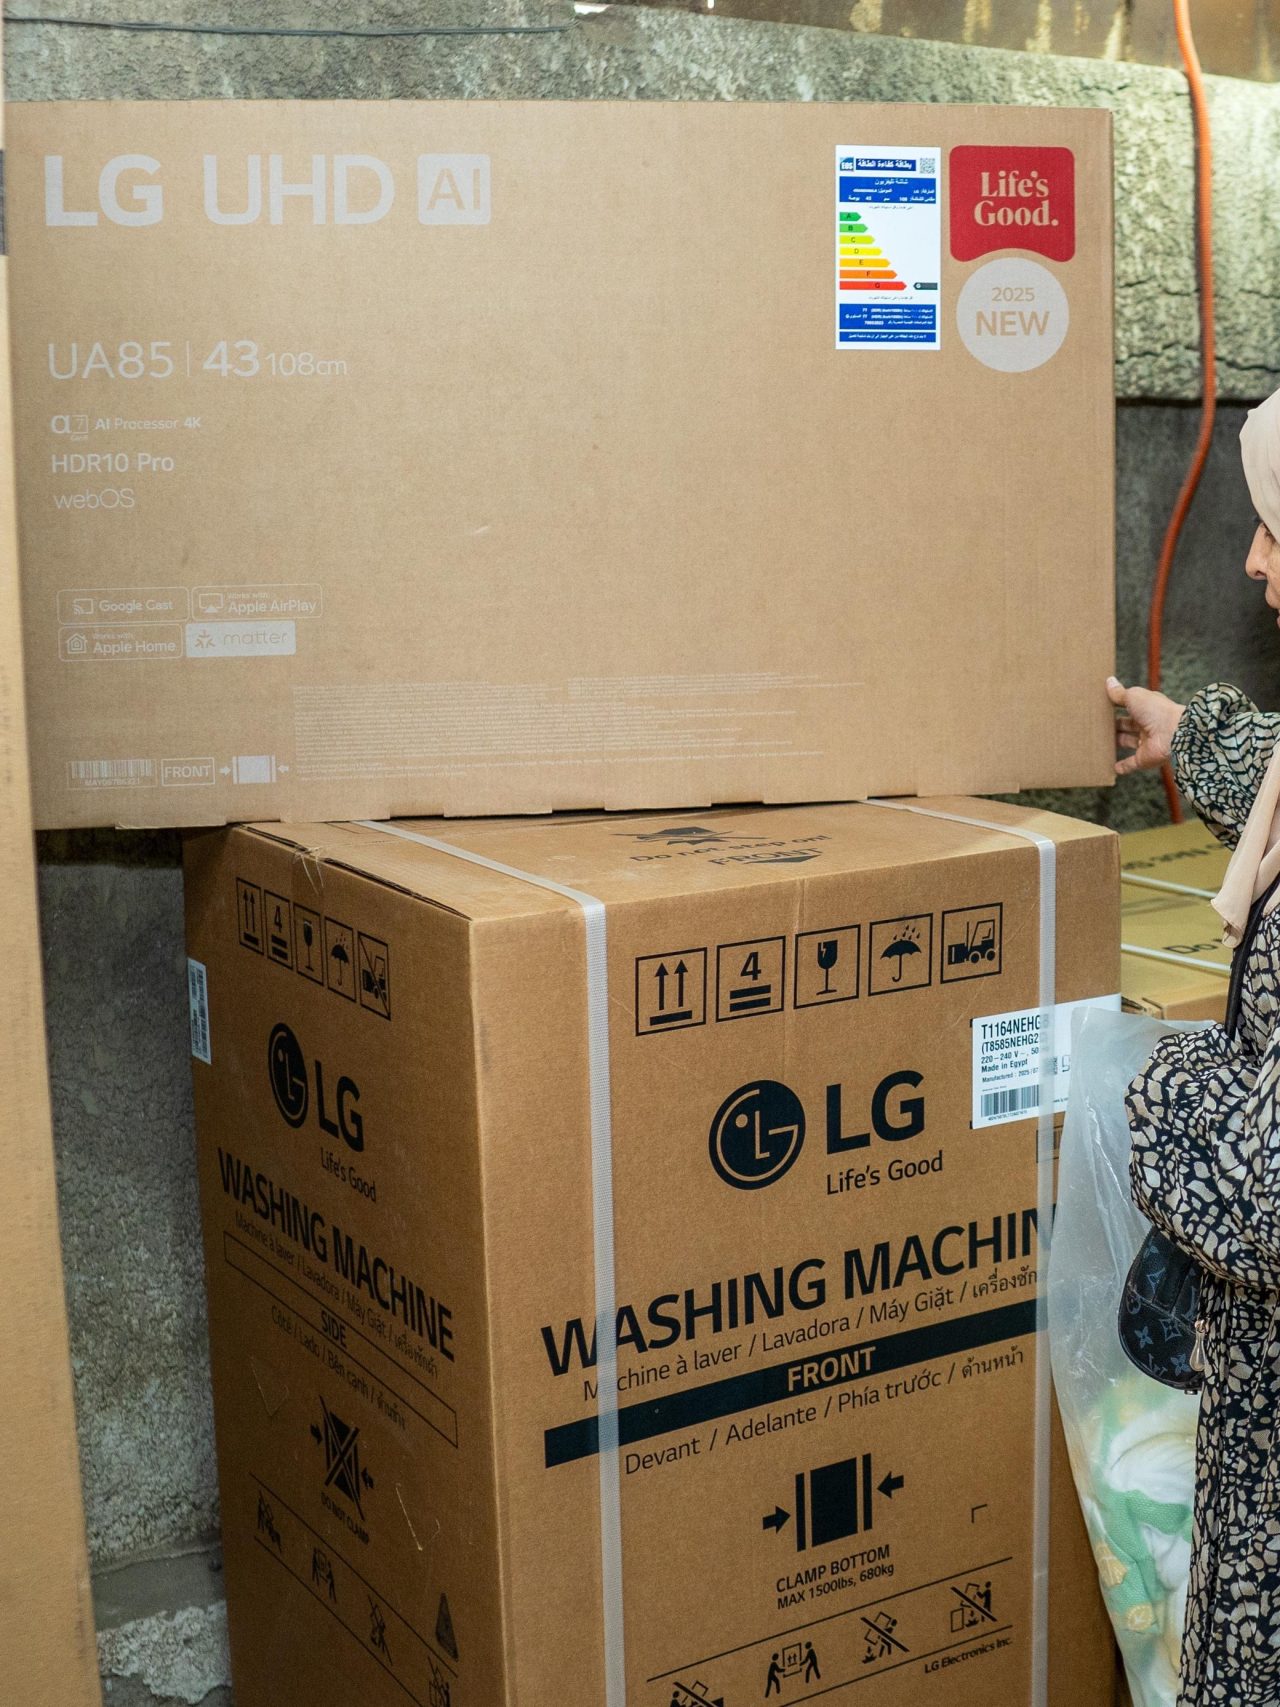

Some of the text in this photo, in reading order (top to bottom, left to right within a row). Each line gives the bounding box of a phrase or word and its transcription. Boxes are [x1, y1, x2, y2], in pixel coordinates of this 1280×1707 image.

[44, 153, 484, 227] LG UHD AI
[974, 200, 1060, 227] Good.
[991, 287, 1036, 303] 2025
[975, 310, 1050, 337] NEW
[48, 340, 348, 380] UA85 43 108cm
[95, 417, 201, 430] AI Processor 4K
[51, 453, 175, 473] HDR10 Pro
[53, 487, 135, 510] webOS
[100, 599, 174, 615] Google Cast
[228, 599, 317, 616] Apple AirPlay
[93, 640, 177, 656] Apple Home
[223, 630, 288, 646] matter
[164, 764, 212, 778] FRONT
[629, 853, 672, 862] Do
[678, 846, 724, 857] not
[728, 838, 787, 850] step
[709, 847, 825, 866] FRONT
[274, 905, 282, 933] 4
[740, 951, 762, 982] 4
[981, 1014, 1048, 1040] T1164NEHG
[981, 1032, 1047, 1055] (T8585NEHG2
[981, 1058, 1028, 1073] Made in Egypt
[315, 1058, 364, 1153] LG
[826, 1069, 925, 1155] LG
[887, 1150, 944, 1182] Good
[350, 1167, 377, 1202] Good
[217, 1146, 455, 1363] WASHING MACHINE
[541, 1204, 1058, 1377] WASHING MACHIN
[973, 1264, 1038, 1298] เครื่องซัก
[321, 1310, 347, 1349] SIDE
[583, 1362, 671, 1402] Mchine
[676, 1355, 688, 1376] à
[694, 1343, 742, 1371] laver
[762, 1317, 850, 1352] Lavadora
[870, 1295, 909, 1324] Máy
[914, 1287, 955, 1312] Giặt
[788, 1346, 877, 1393] FRONT
[625, 1437, 700, 1475] Devant
[725, 1406, 817, 1445] Adelante
[838, 1387, 880, 1413] Phía
[886, 1368, 942, 1400] trước
[776, 1543, 890, 1593] CLAMP BOTTOM
[777, 1563, 895, 1610] MAX 1500lbs, 680kg
[924, 1637, 1012, 1674] LG Electronics Inc.
